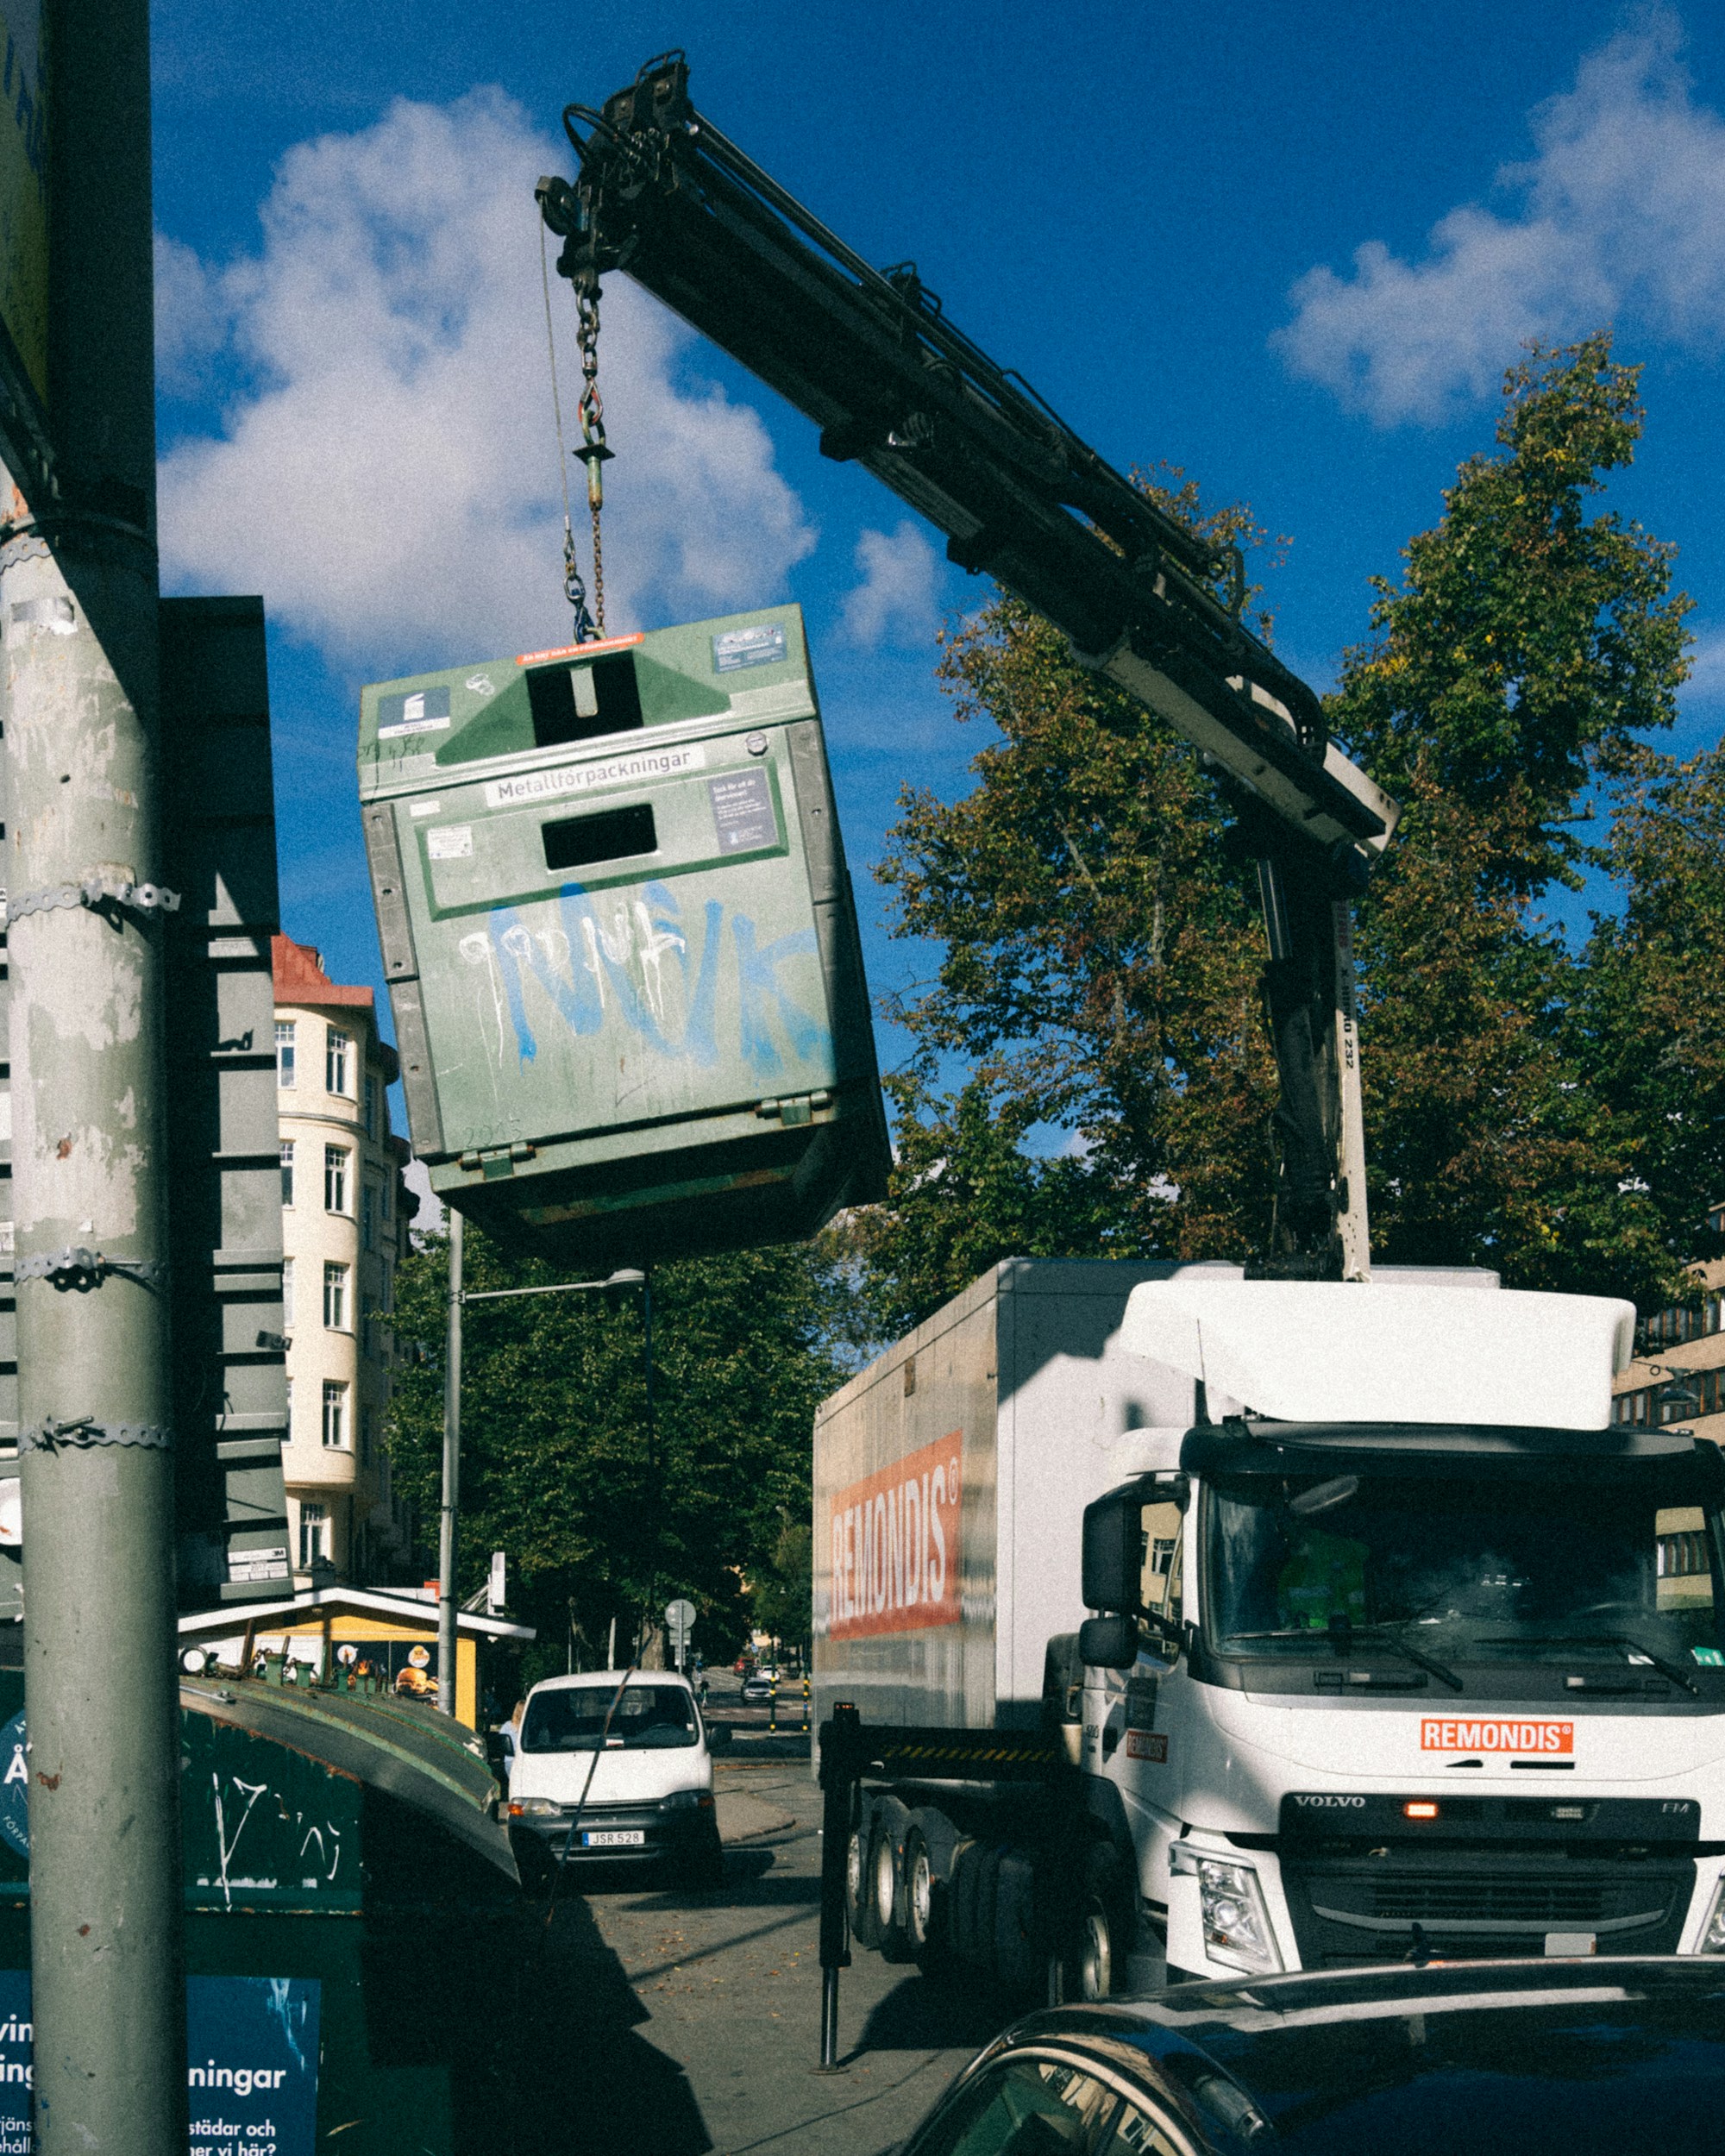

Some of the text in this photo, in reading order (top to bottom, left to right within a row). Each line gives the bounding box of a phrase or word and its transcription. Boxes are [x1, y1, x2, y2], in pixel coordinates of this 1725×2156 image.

[498, 751, 692, 799] Metallförpackningar
[1345, 1038, 1354, 1069] 232
[1294, 1796, 1365, 1808] VOLVO
[1662, 1802, 1690, 1814] FM
[593, 1833, 639, 1844] JSR 528
[188, 2059, 286, 2096] ningar
[189, 2118, 242, 2136] städar
[246, 2119, 276, 2137] och
[217, 2142, 232, 2156] vi
[238, 2141, 277, 2156] här?
